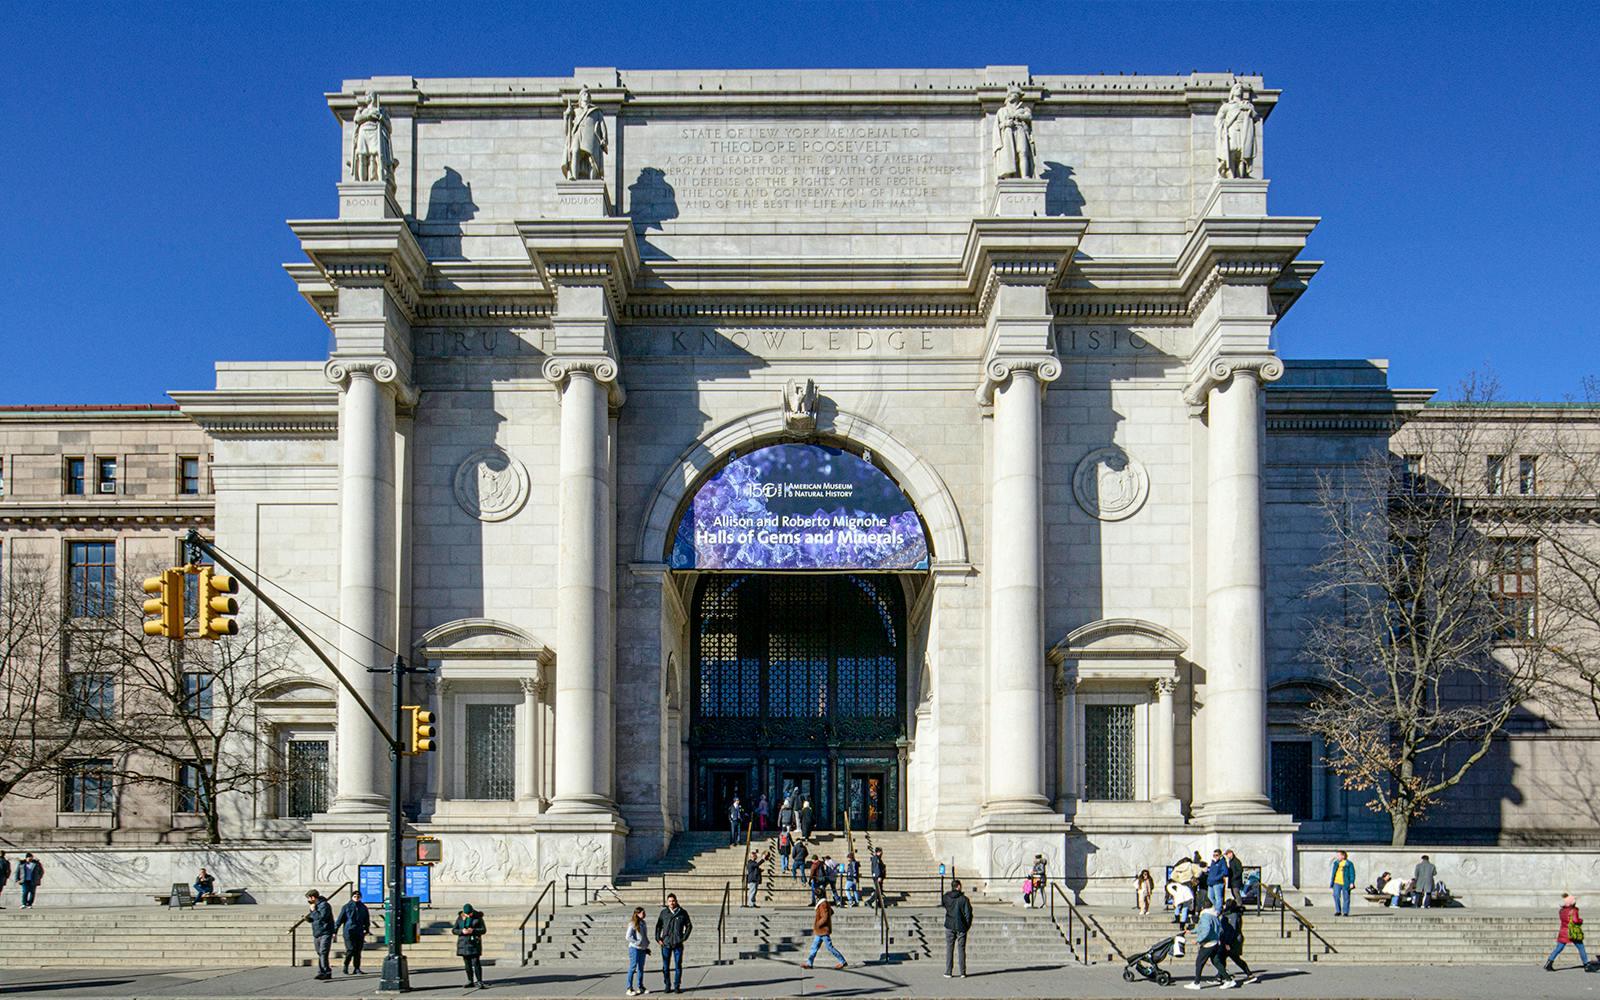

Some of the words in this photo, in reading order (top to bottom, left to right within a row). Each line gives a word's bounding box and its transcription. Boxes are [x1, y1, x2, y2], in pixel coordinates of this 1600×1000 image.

[682, 128, 721, 139] STATE
[726, 128, 743, 139] OF
[750, 128, 779, 139] NEW
[785, 128, 820, 139] YORK
[826, 128, 898, 139] MEMORIAL
[903, 128, 920, 139] TO
[710, 141, 796, 152] THEODORE
[802, 141, 891, 152] ROOSEVELT
[678, 156, 715, 164] GREAT
[722, 156, 764, 164] LEADER
[770, 156, 785, 164] OF
[792, 156, 812, 164] THE
[820, 156, 858, 164] YOUTH
[865, 156, 880, 164] OF
[884, 156, 934, 164] AMERICA
[701, 166, 724, 175] AND
[729, 166, 788, 175] FORTITUDE
[794, 166, 804, 175] IN
[810, 166, 830, 175] THE
[834, 166, 865, 175] FAITH
[870, 166, 884, 175] OF
[889, 166, 911, 175] OUR
[917, 166, 962, 175] FATHERS
[692, 178, 740, 186] DEFENSE
[745, 178, 760, 186] OF
[766, 178, 786, 186] THE
[792, 178, 834, 186] RIGHTS
[840, 178, 854, 186] OF
[860, 178, 880, 186] THE
[886, 178, 927, 186] PEOPLE
[682, 188, 702, 198] THE
[709, 188, 740, 198] LOVE
[744, 188, 768, 198] AND
[774, 188, 864, 198] CONSERVATION
[870, 188, 884, 198] OF
[891, 188, 937, 198] NATURE
[560, 197, 602, 205] AUDUBON
[686, 200, 710, 209] AND
[716, 200, 729, 209] OF
[736, 200, 760, 209] THE
[764, 200, 789, 209] BEST
[814, 200, 836, 209] LIFE
[842, 200, 867, 209] AND
[891, 200, 916, 209] MAN
[424, 332, 556, 351] TRUTH
[672, 331, 934, 351] KNOWLEDGE
[713, 516, 753, 527] Allison
[757, 516, 778, 527] and
[782, 516, 830, 527] Roberto
[833, 516, 886, 530] Mignone
[697, 530, 734, 544] Halls
[737, 530, 754, 544] of
[757, 530, 800, 544] Gems
[805, 530, 834, 544] and
[838, 530, 904, 544] Minerals
